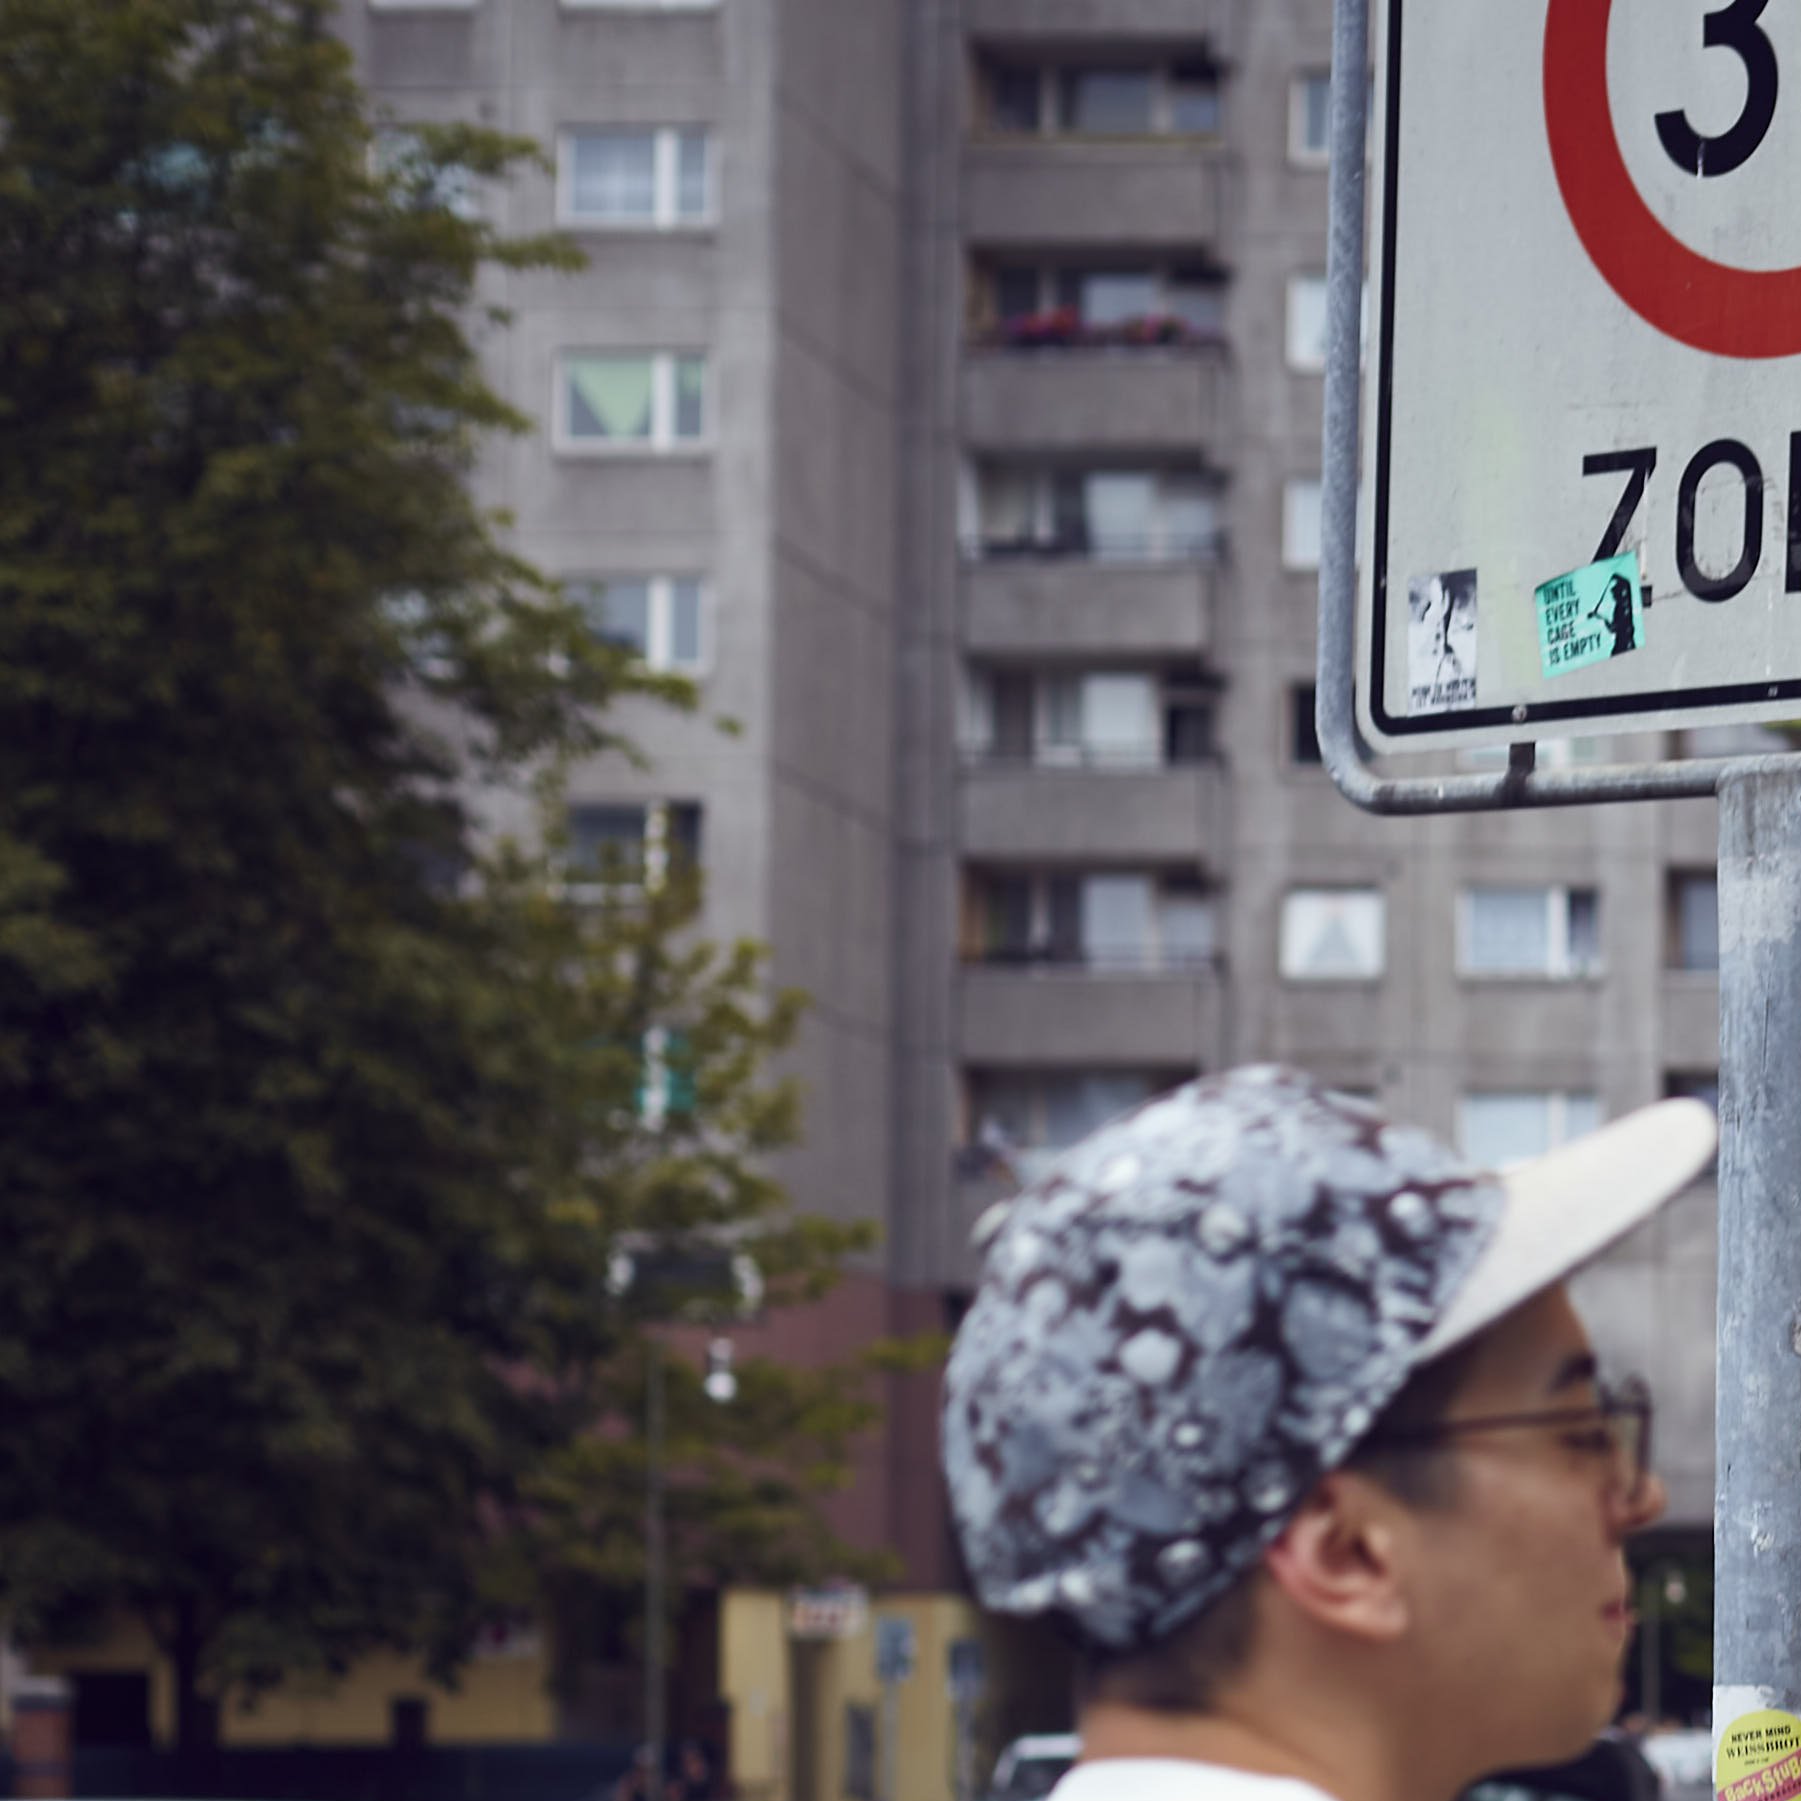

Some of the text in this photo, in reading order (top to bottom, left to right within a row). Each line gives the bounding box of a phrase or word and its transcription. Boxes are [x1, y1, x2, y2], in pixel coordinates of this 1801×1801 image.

[1543, 579, 1576, 605] UNTIL
[1545, 598, 1580, 626] EVERY
[1547, 620, 1576, 645] CAGE
[1549, 633, 1601, 667] IS EMPTY
[1731, 1725, 1791, 1743] NEVER MIND
